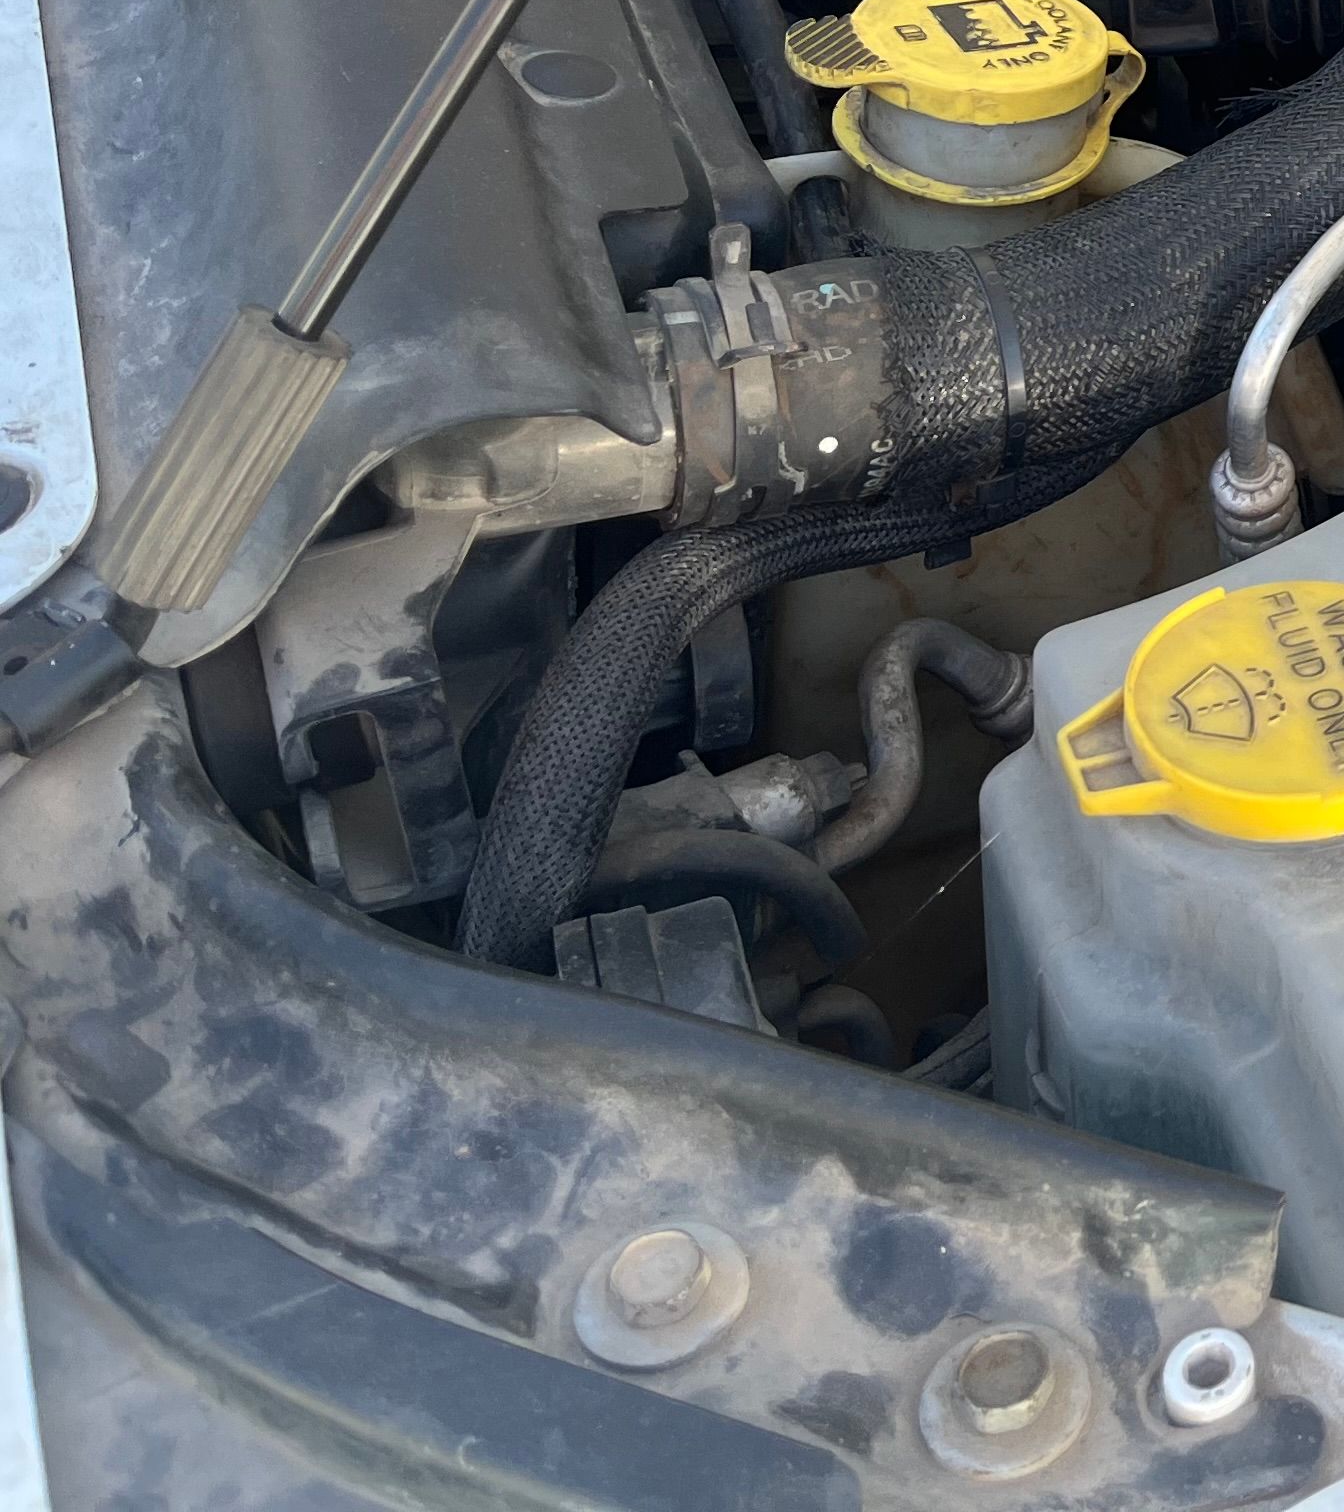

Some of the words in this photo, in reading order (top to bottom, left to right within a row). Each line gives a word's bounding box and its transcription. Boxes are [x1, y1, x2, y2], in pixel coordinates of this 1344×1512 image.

[981, 51, 1050, 71] ONLY
[791, 279, 880, 314] RAD
[1259, 589, 1327, 681] FLUID
